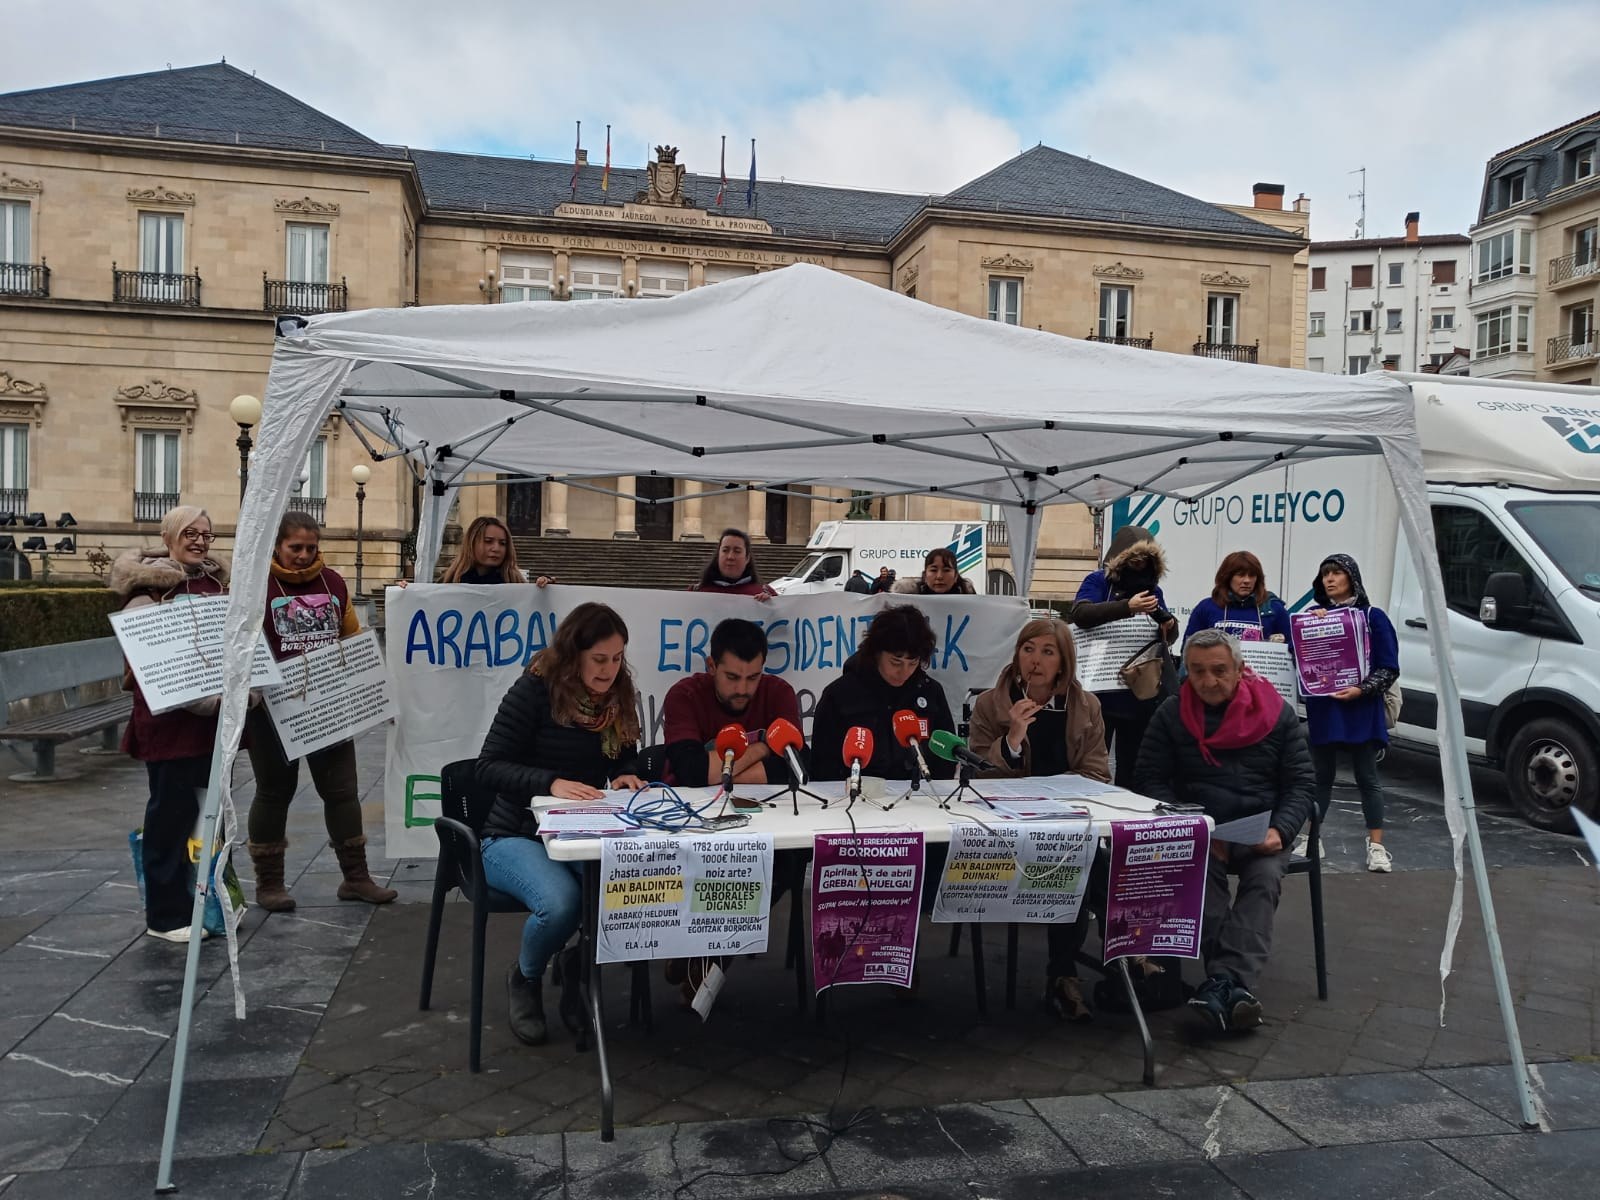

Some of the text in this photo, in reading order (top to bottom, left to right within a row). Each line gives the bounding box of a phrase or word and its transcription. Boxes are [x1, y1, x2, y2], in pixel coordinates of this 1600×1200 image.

[558, 206, 769, 232] ALDUNDIAREN JAUREGIA PALACIO DE LA PROVINCIA
[498, 232, 550, 244] ARABAKO
[604, 241, 655, 253] ALDUNDIA
[736, 251, 769, 262] FORAL
[774, 254, 786, 263] DE
[1477, 401, 1600, 417] GRUPO ELEYC
[1173, 488, 1345, 526] GRUPO ELEYCO
[859, 549, 929, 559] GRUPO ELEYC
[961, 827, 1019, 838] 1782h. anuales
[1028, 832, 1046, 841] 1782
[1047, 832, 1066, 841] ordu
[1135, 826, 1194, 842] BORROKAN!!
[614, 840, 680, 851] 1782h. anuales
[692, 841, 767, 852] 1782 ordu urteko
[863, 837, 919, 846] ERRESIDENTZIAK
[962, 838, 1016, 849] 1000€ al mes
[1035, 842, 1058, 851] 1000€
[838, 846, 909, 858] BORROKAN!!
[1129, 846, 1154, 855] Apirilak
[1166, 843, 1176, 851] de
[1177, 843, 1193, 851] abril
[616, 853, 677, 864] 1000€ al mes
[701, 852, 758, 864] 1000€ hilean
[953, 851, 982, 861] ¿hasta
[1036, 854, 1054, 863] noiz
[1161, 851, 1192, 860] HUELGA!
[949, 862, 1016, 871] LAN BALDINTZA
[609, 865, 682, 881] ¿hasta cuando?
[705, 867, 752, 878] noiz arte?
[824, 868, 858, 878] Apirilak
[875, 869, 888, 878] de
[890, 868, 912, 878] abril
[962, 872, 1000, 881] DUINAK!
[606, 880, 683, 894] LAN BALDINTZA
[694, 881, 761, 893] CONDICIONES
[822, 879, 912, 889] GREBA! HUELGA!
[1031, 880, 1067, 889] DIGNAS!
[623, 892, 666, 905] DUINAK!
[699, 891, 755, 902] LABORALES
[706, 901, 747, 912] DIGNAS!
[608, 909, 678, 921] ARABAKO HELDUEN
[604, 919, 681, 932] EGOITZAK BORROKAN
[690, 916, 760, 926] ARABAKO HELDUEN
[688, 924, 762, 934] EGOITZAK BORROKAN
[625, 941, 639, 950] ELA
[644, 940, 659, 949] LAB
[708, 942, 721, 950] ELA
[727, 941, 741, 949] LAB
